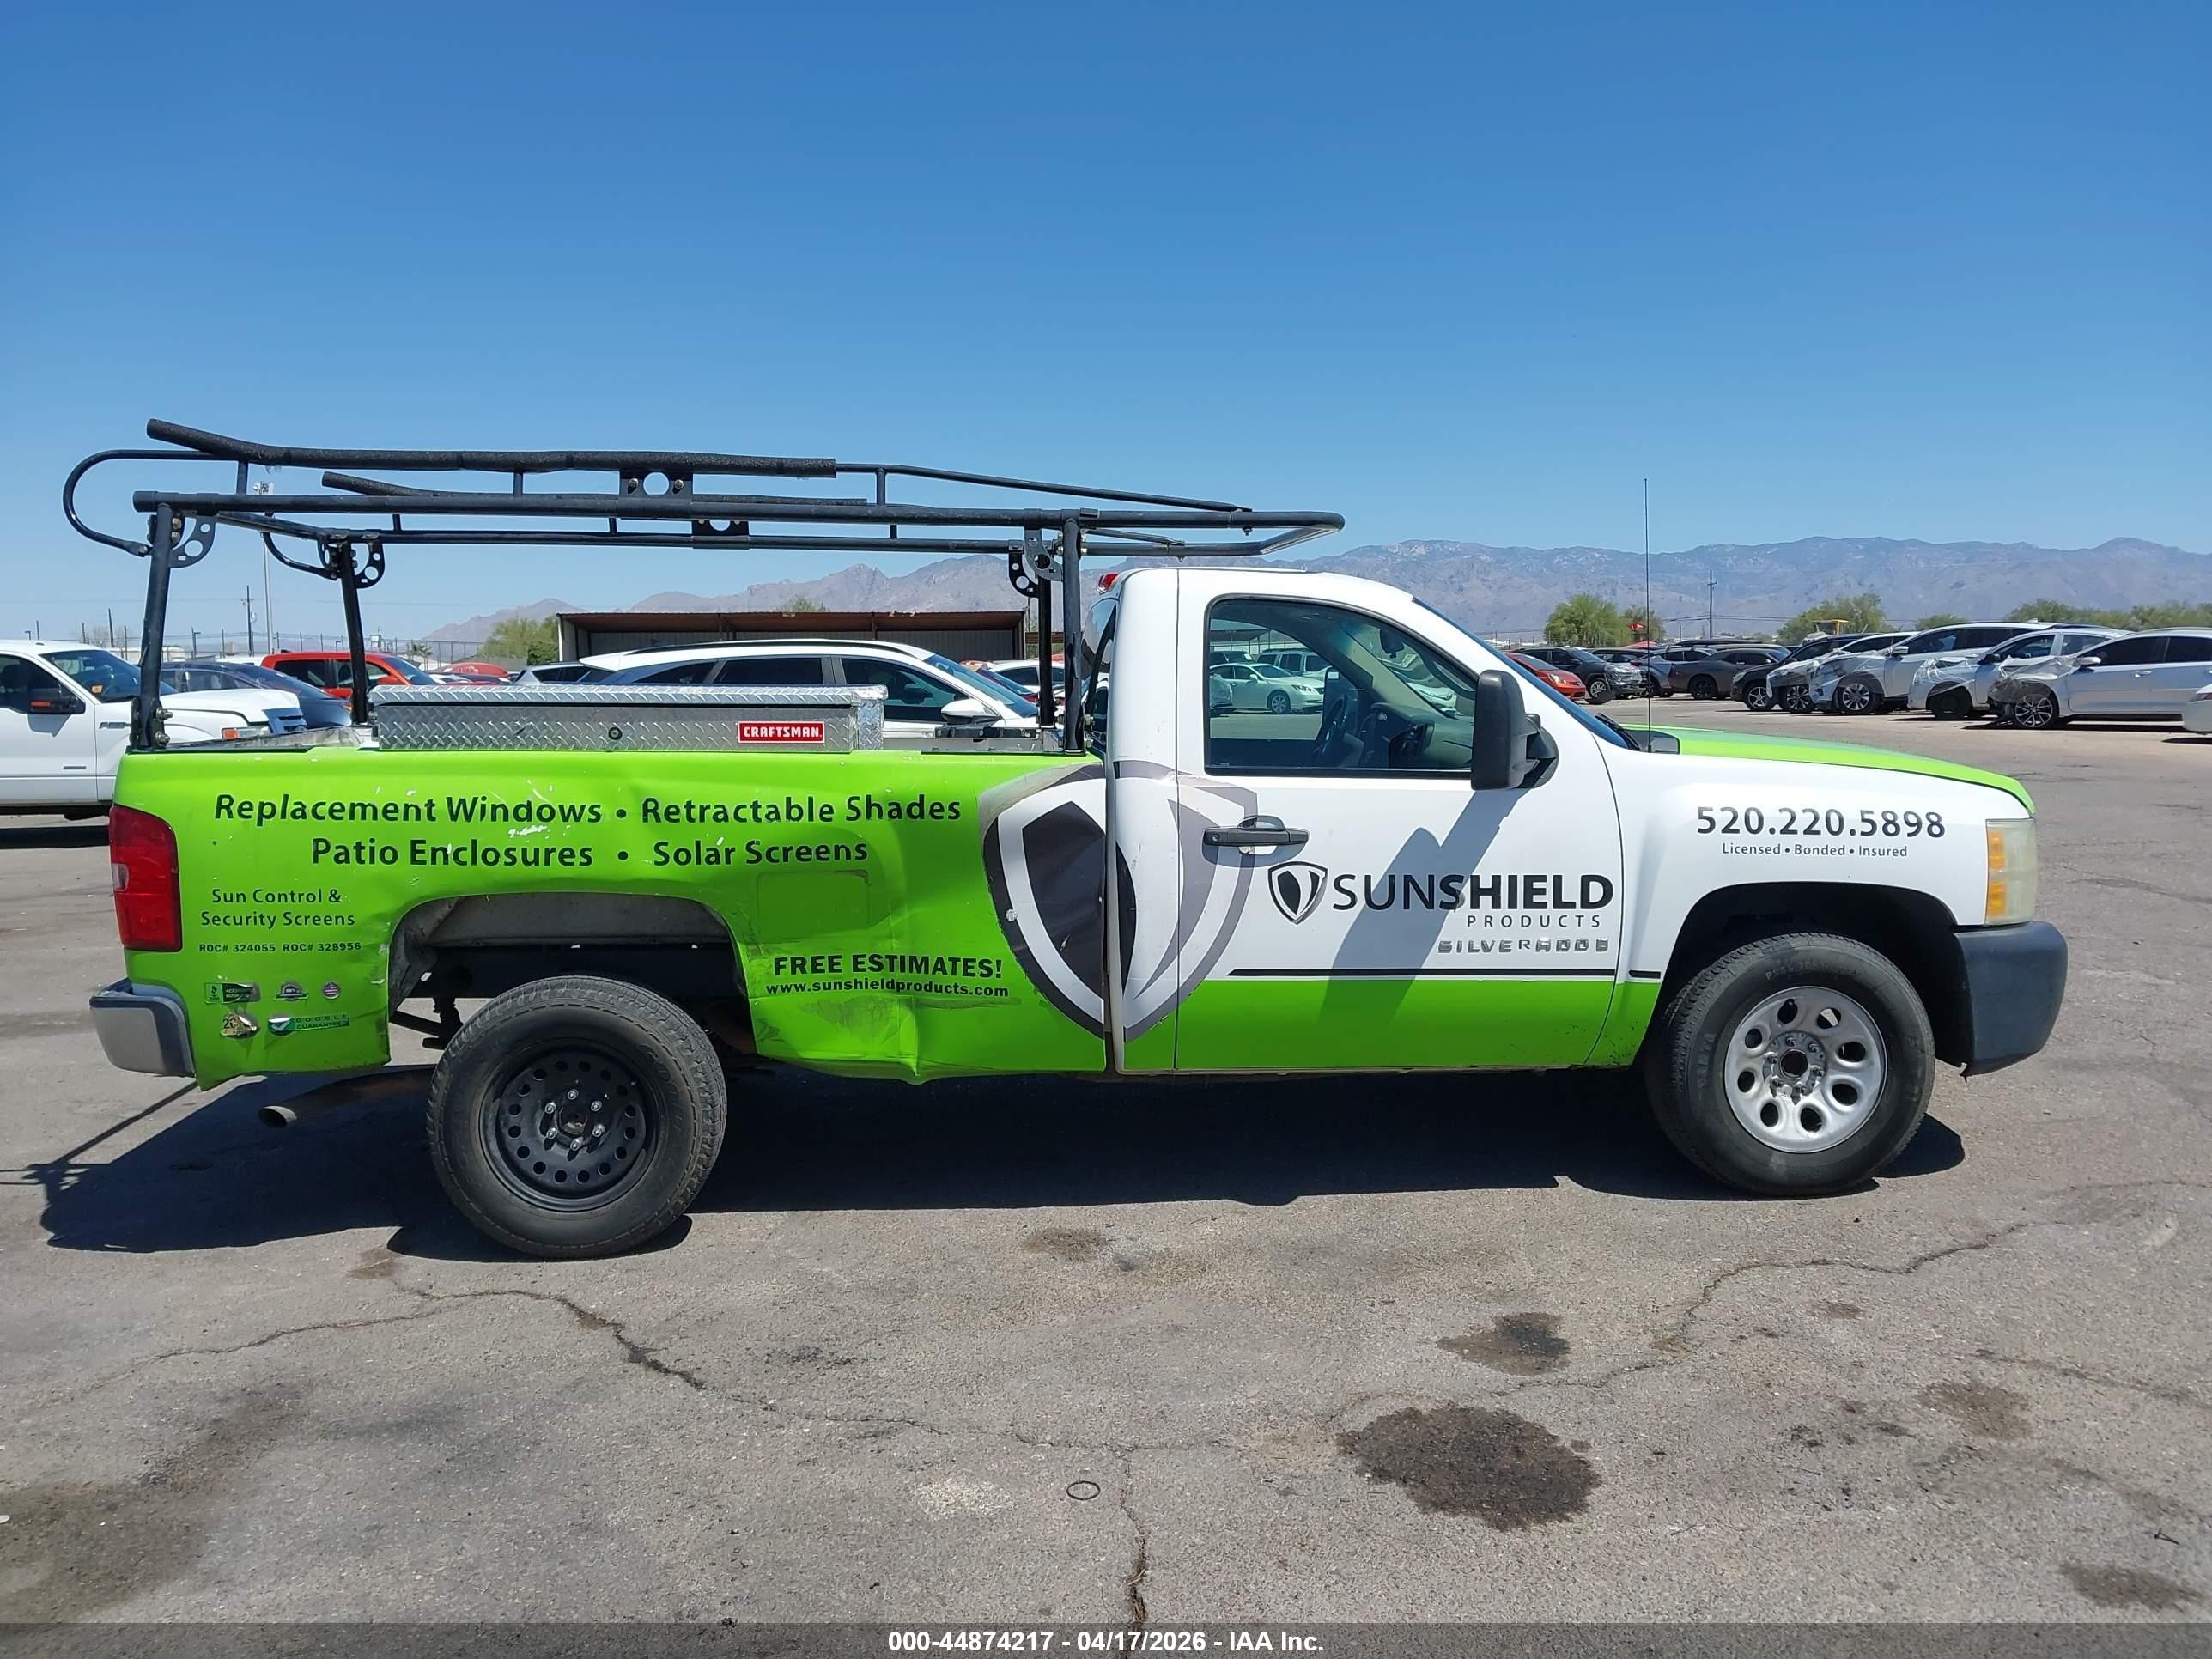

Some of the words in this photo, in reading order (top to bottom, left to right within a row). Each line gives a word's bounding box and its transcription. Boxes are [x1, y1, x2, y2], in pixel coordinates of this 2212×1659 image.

[215, 793, 437, 827] Replacement
[446, 795, 603, 823] Windows
[641, 796, 835, 823] Retractable
[845, 793, 962, 823] Shades
[1697, 807, 1945, 838] 520.220.5898
[313, 837, 398, 866] Patio
[410, 838, 593, 867] Enclosures
[653, 840, 736, 866] Solar
[745, 840, 868, 865] Screens
[1722, 842, 1781, 855] Licensed
[1794, 843, 1845, 856] Bonded
[1858, 845, 1907, 857] Insured
[212, 888, 246, 903] Sun
[252, 888, 322, 903] Control
[328, 889, 342, 903] &
[1333, 874, 1613, 911] SUNSHIELD
[201, 911, 276, 930] Security
[283, 911, 356, 927] Screens
[1467, 915, 1600, 928] PRODUCTS
[198, 944, 228, 952] ROC#
[233, 944, 276, 952] 324055
[282, 943, 313, 952] ROC#
[317, 942, 362, 951] 328956
[774, 955, 843, 975] FREE
[852, 954, 1002, 979] ESTIMATES!
[766, 978, 1009, 997] www.sunshieldproducts.com
